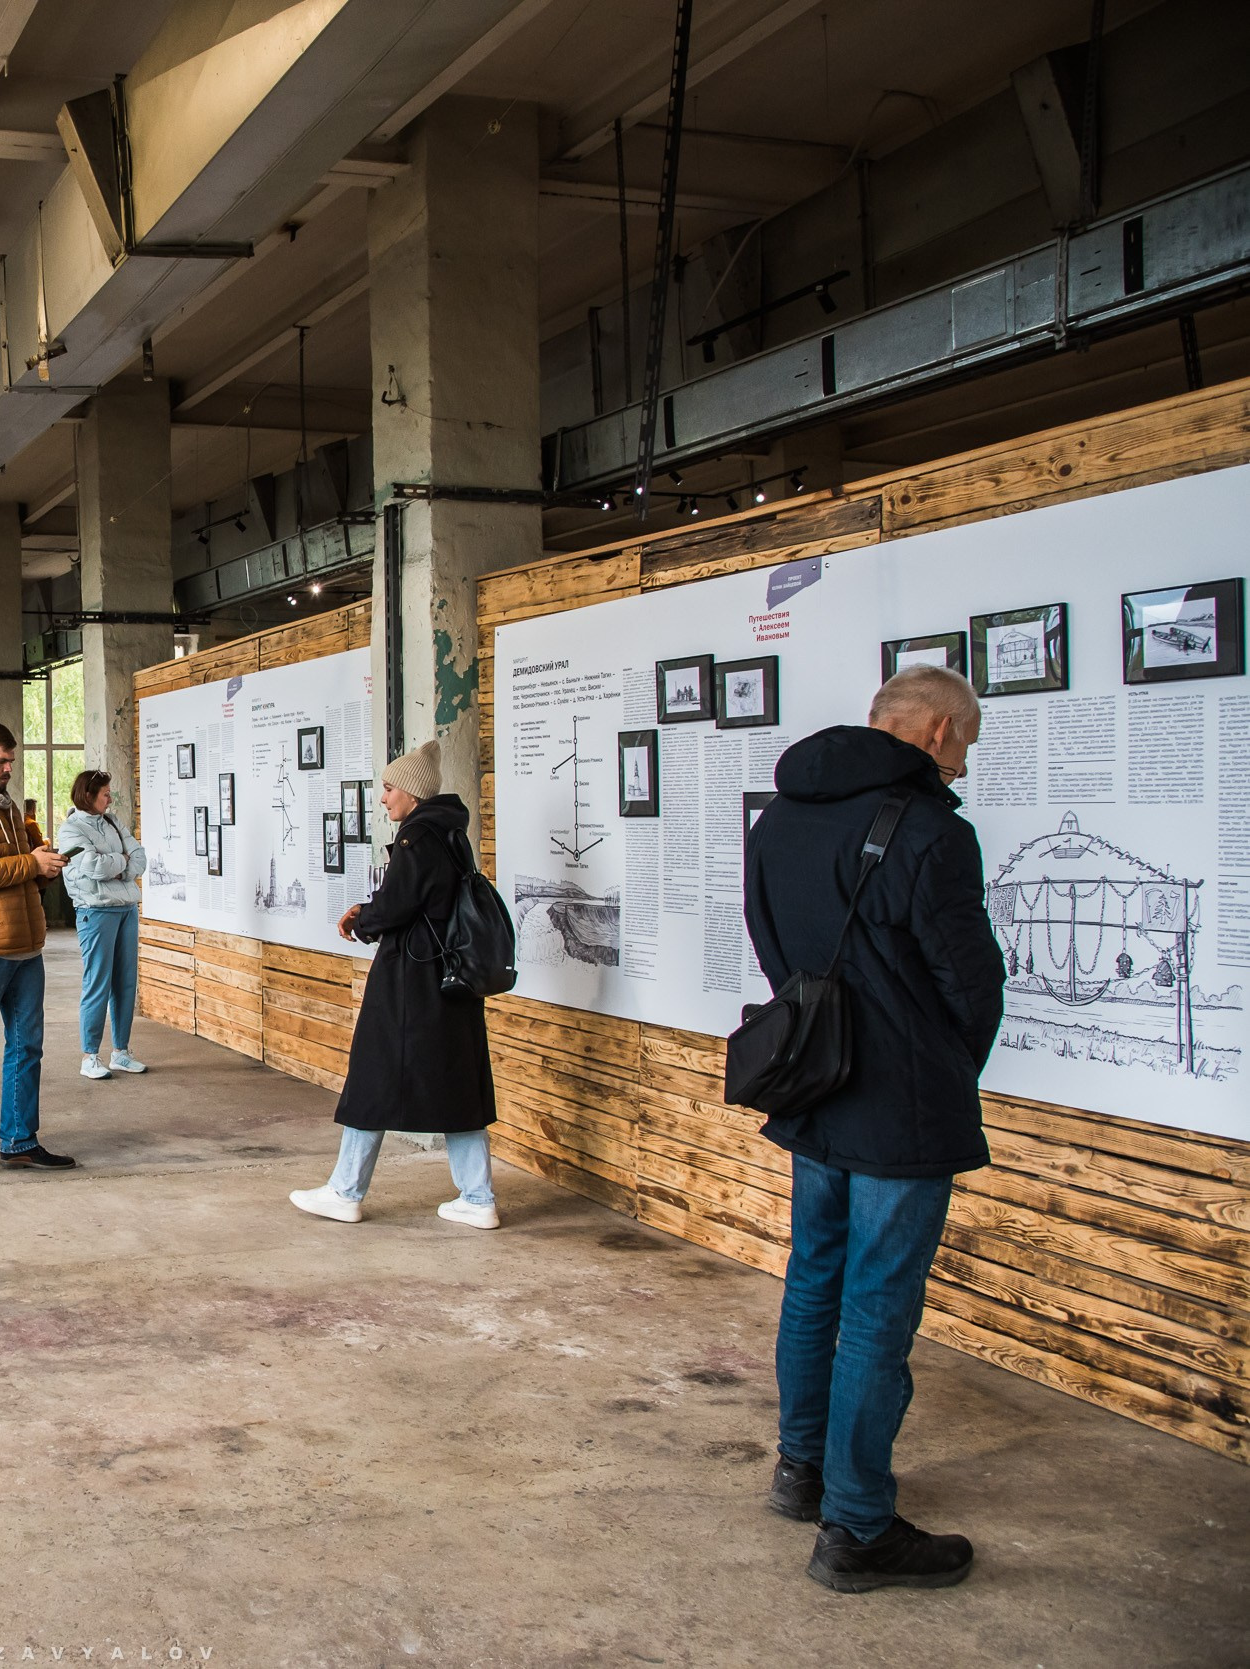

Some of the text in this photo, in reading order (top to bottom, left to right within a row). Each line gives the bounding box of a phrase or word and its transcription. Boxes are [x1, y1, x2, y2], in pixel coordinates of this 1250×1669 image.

[748, 611, 790, 624] Путешествия
[758, 622, 790, 632] Алексеем
[756, 632, 790, 642] Ивановым
[512, 660, 570, 678] ДЕМИДОВСКИЙ УРАЛ
